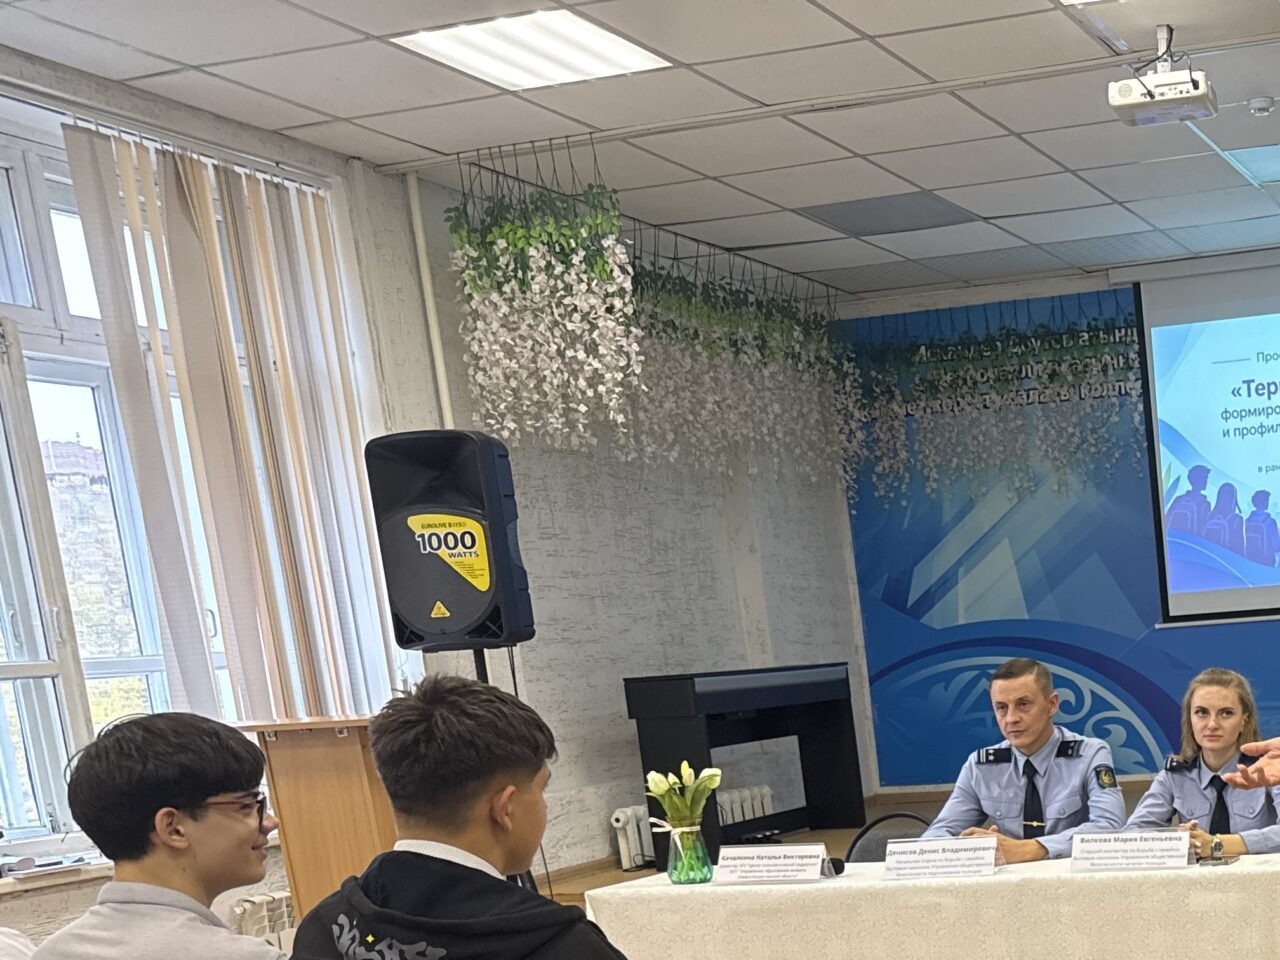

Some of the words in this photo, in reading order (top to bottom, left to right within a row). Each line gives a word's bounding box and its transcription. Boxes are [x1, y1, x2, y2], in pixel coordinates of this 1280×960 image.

[1222, 427, 1231, 438] и
[1257, 466, 1264, 474] в
[416, 531, 477, 553] 1000
[447, 550, 480, 559] WATTS
[1080, 836, 1112, 844] Вилкова
[1113, 835, 1138, 845] Мария
[1139, 834, 1183, 843] Евгеньевна
[887, 848, 917, 857] Денисов
[918, 847, 940, 857] Денис
[941, 845, 996, 855] Владимирович
[756, 853, 782, 861] Наталья
[782, 853, 821, 861] Викторовна
